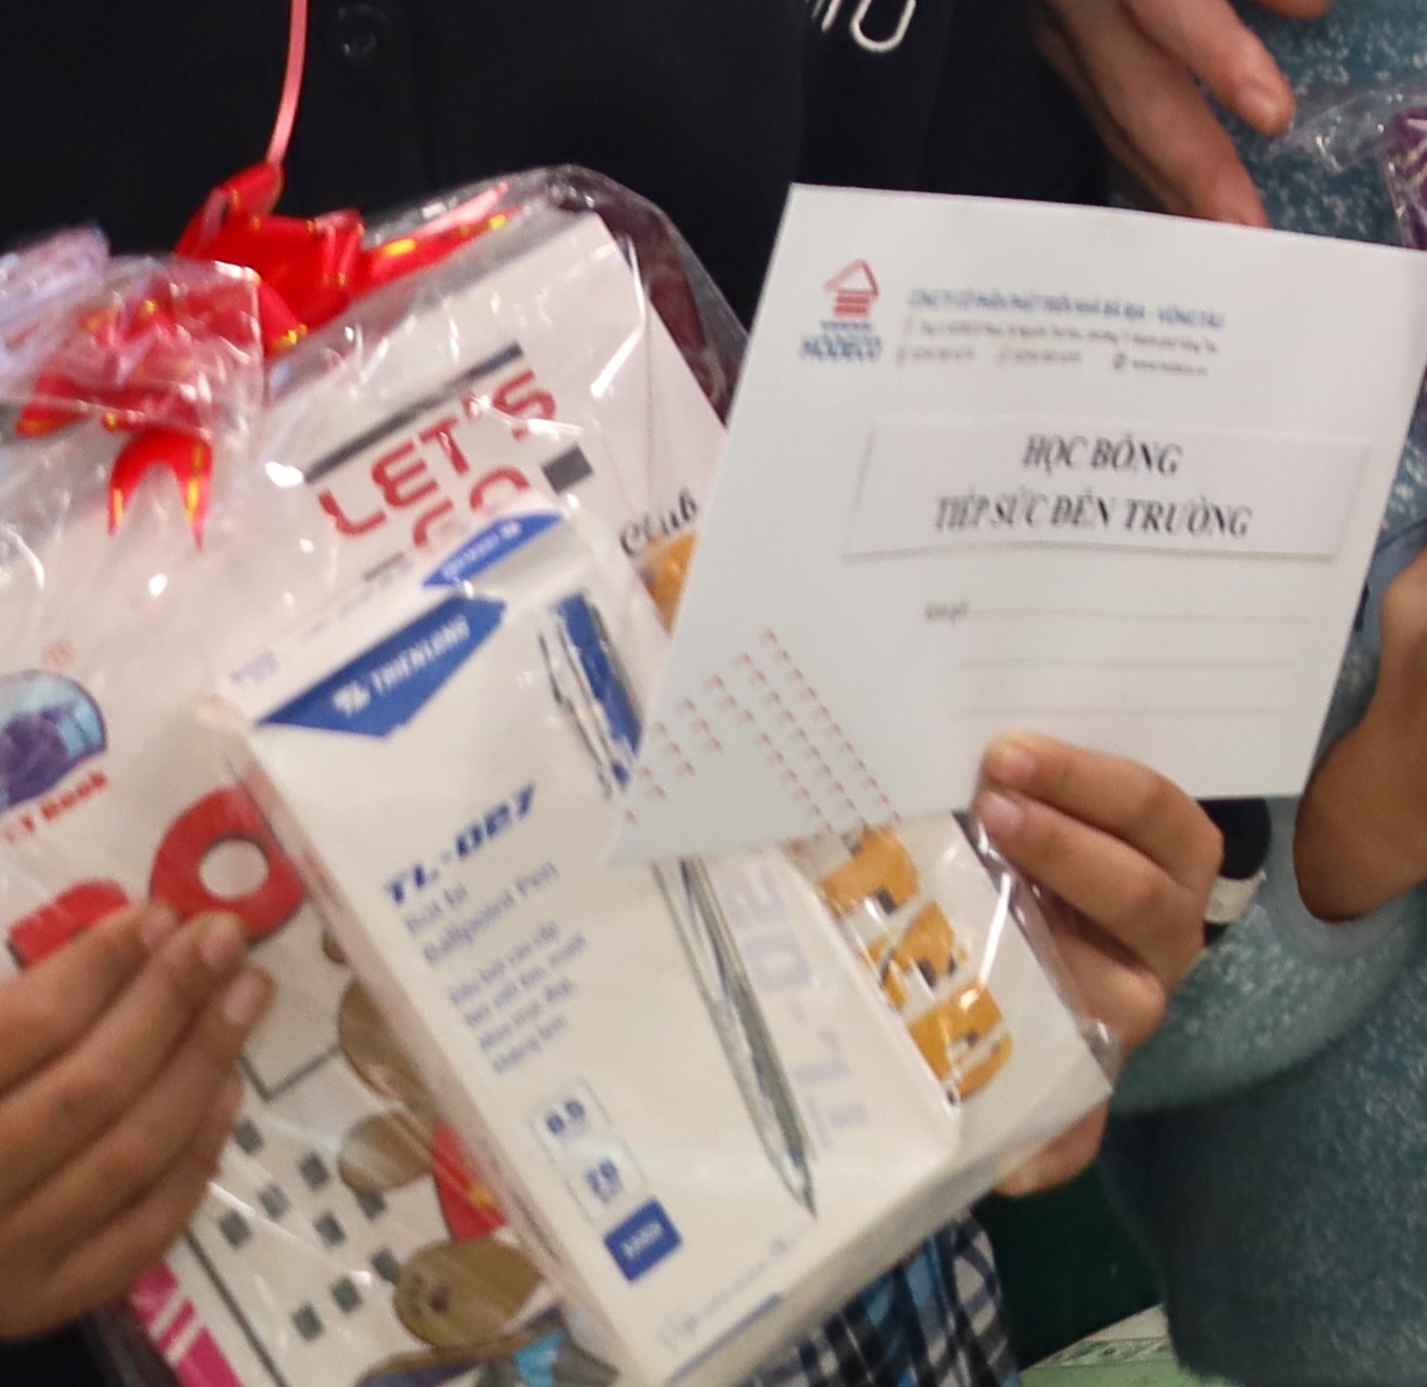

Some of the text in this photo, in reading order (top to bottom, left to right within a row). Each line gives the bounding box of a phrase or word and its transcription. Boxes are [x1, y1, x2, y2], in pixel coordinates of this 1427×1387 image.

[317, 367, 558, 537] LET'S
[1022, 433, 1088, 477] HỌC
[1123, 492, 1253, 539] TRƯỜNG
